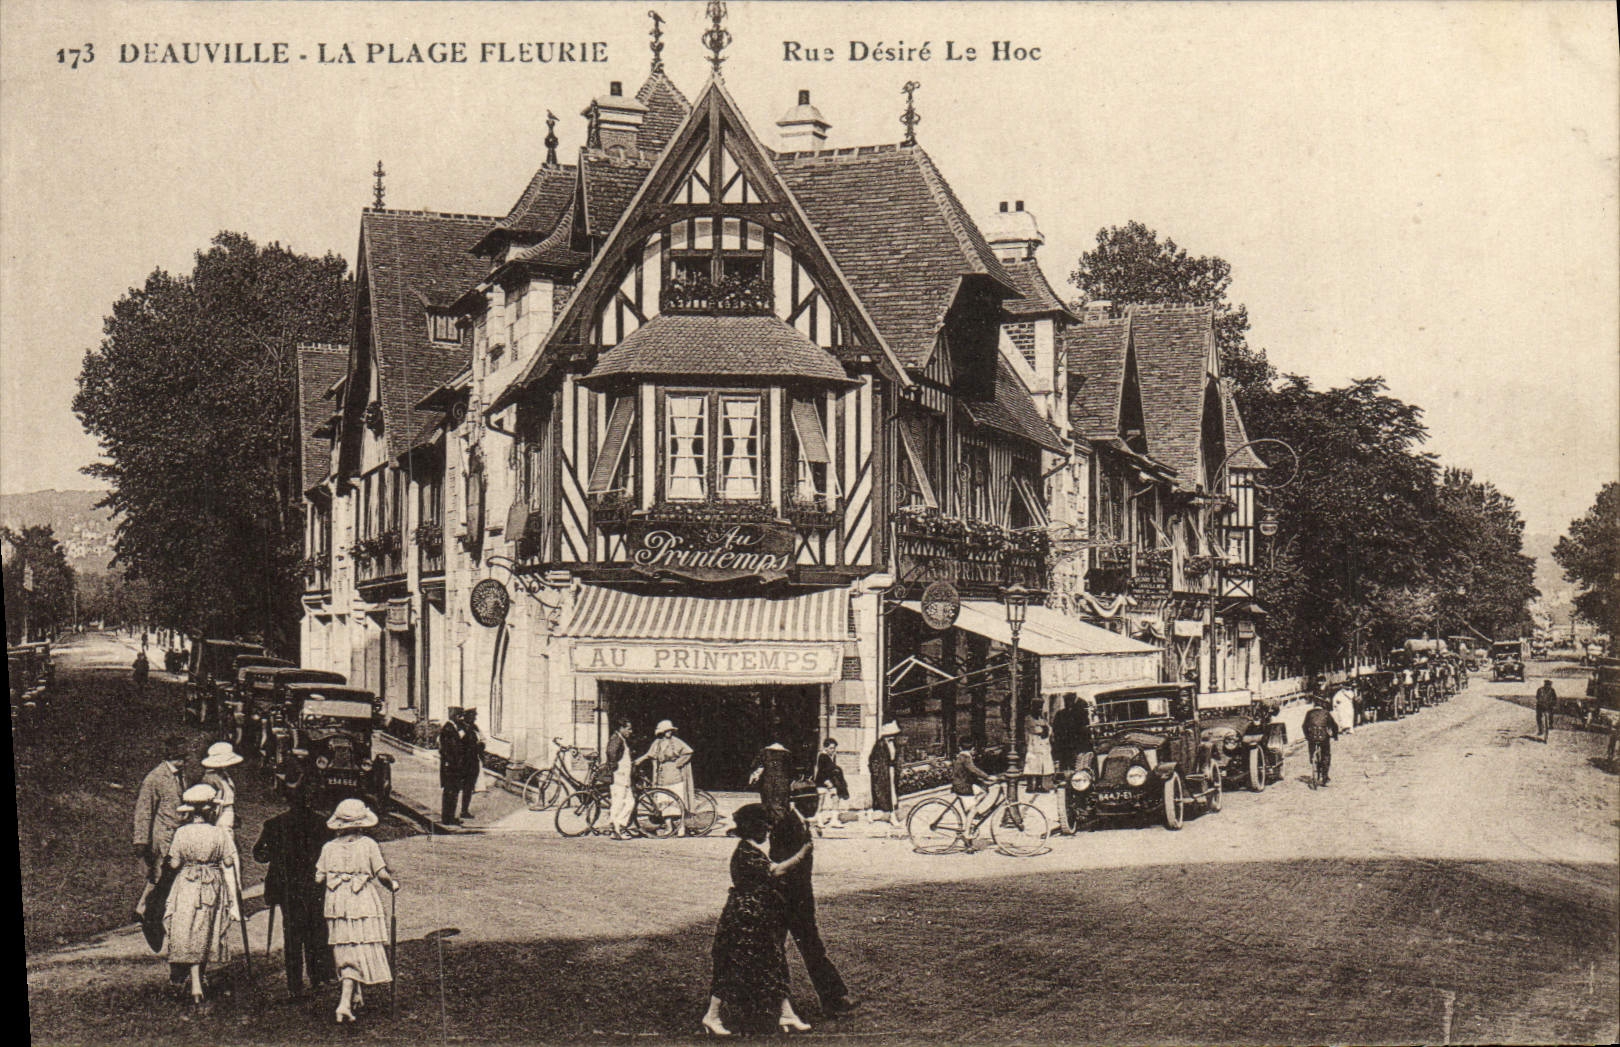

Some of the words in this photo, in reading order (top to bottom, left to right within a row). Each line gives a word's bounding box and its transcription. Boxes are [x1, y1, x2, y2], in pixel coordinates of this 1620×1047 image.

[706, 525, 765, 550] Au
[635, 530, 790, 575] Printemps
[590, 648, 627, 667] AU
[654, 649, 818, 671] PRINTEMPS
